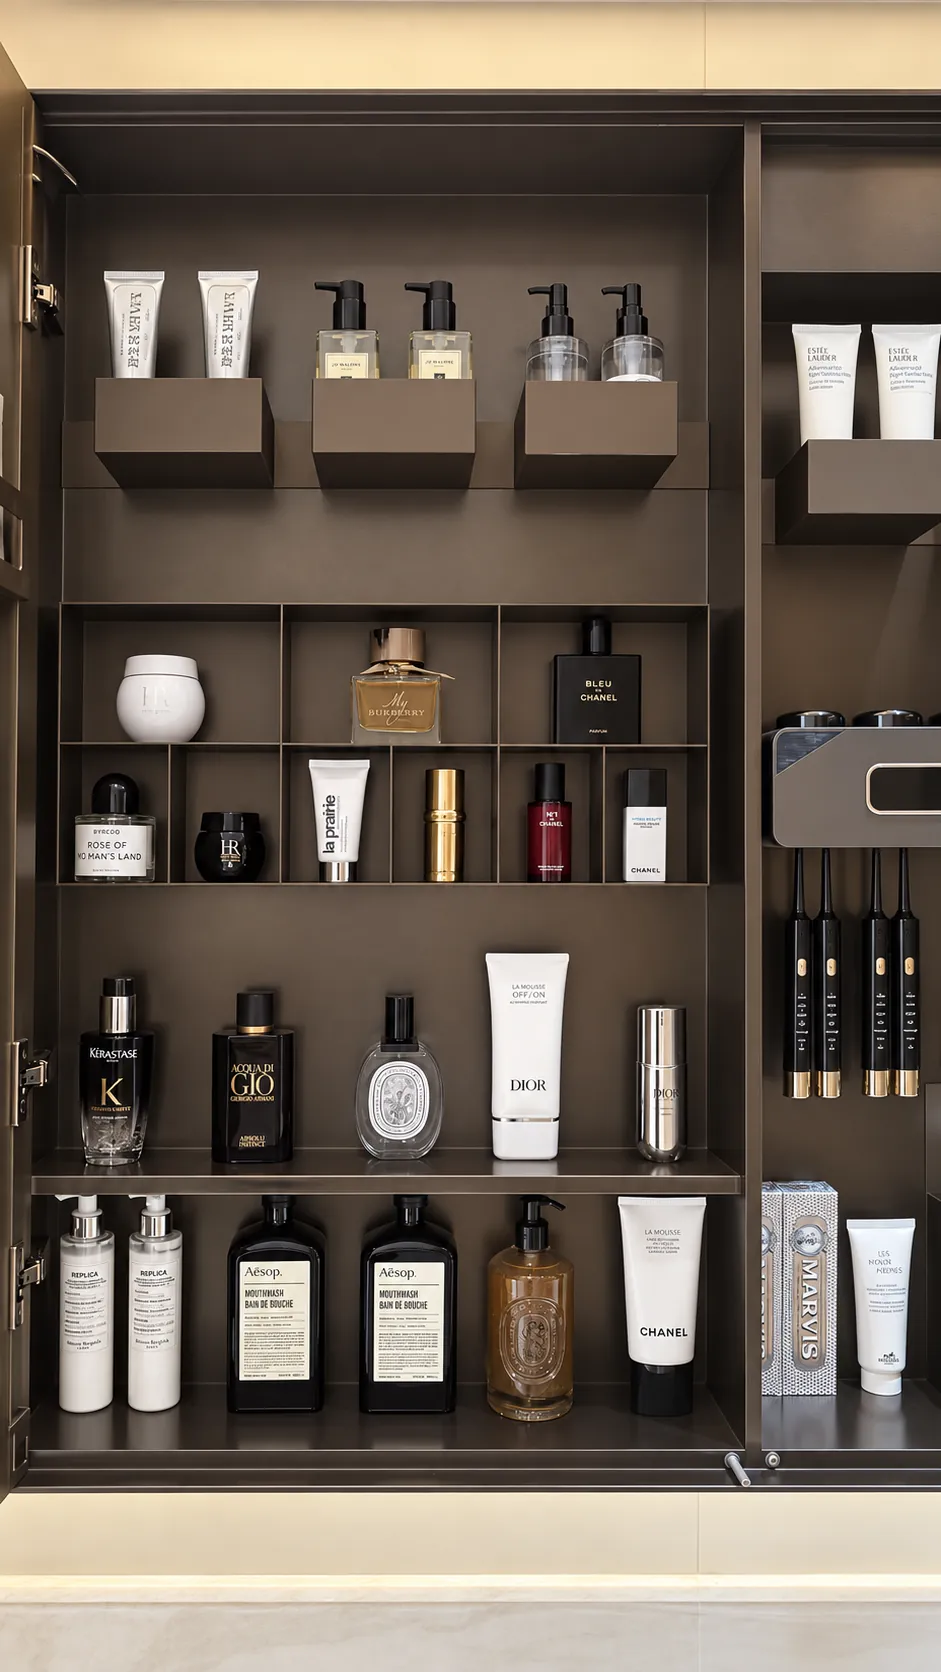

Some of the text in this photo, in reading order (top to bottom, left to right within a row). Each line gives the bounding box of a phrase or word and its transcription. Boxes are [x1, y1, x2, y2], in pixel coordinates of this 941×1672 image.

[585, 680, 612, 688] BLEU
[580, 694, 618, 702] CHANEL
[382, 690, 408, 726] My
[322, 794, 340, 854] la prairie
[87, 841, 127, 849] ROSE OF
[220, 839, 241, 857] HR
[87, 852, 116, 860] MAN'S
[118, 853, 142, 861] LAND
[231, 1063, 275, 1073] ACQUA DI
[510, 1079, 547, 1091] DIOR
[101, 1077, 124, 1106] K
[653, 1088, 680, 1099] DIOR
[71, 1271, 99, 1279] REPLICA
[140, 1269, 168, 1277] REPLICA
[260, 1299, 268, 1308] DE
[801, 1258, 819, 1361] MARVIS
[640, 1326, 688, 1338] CHANEL
